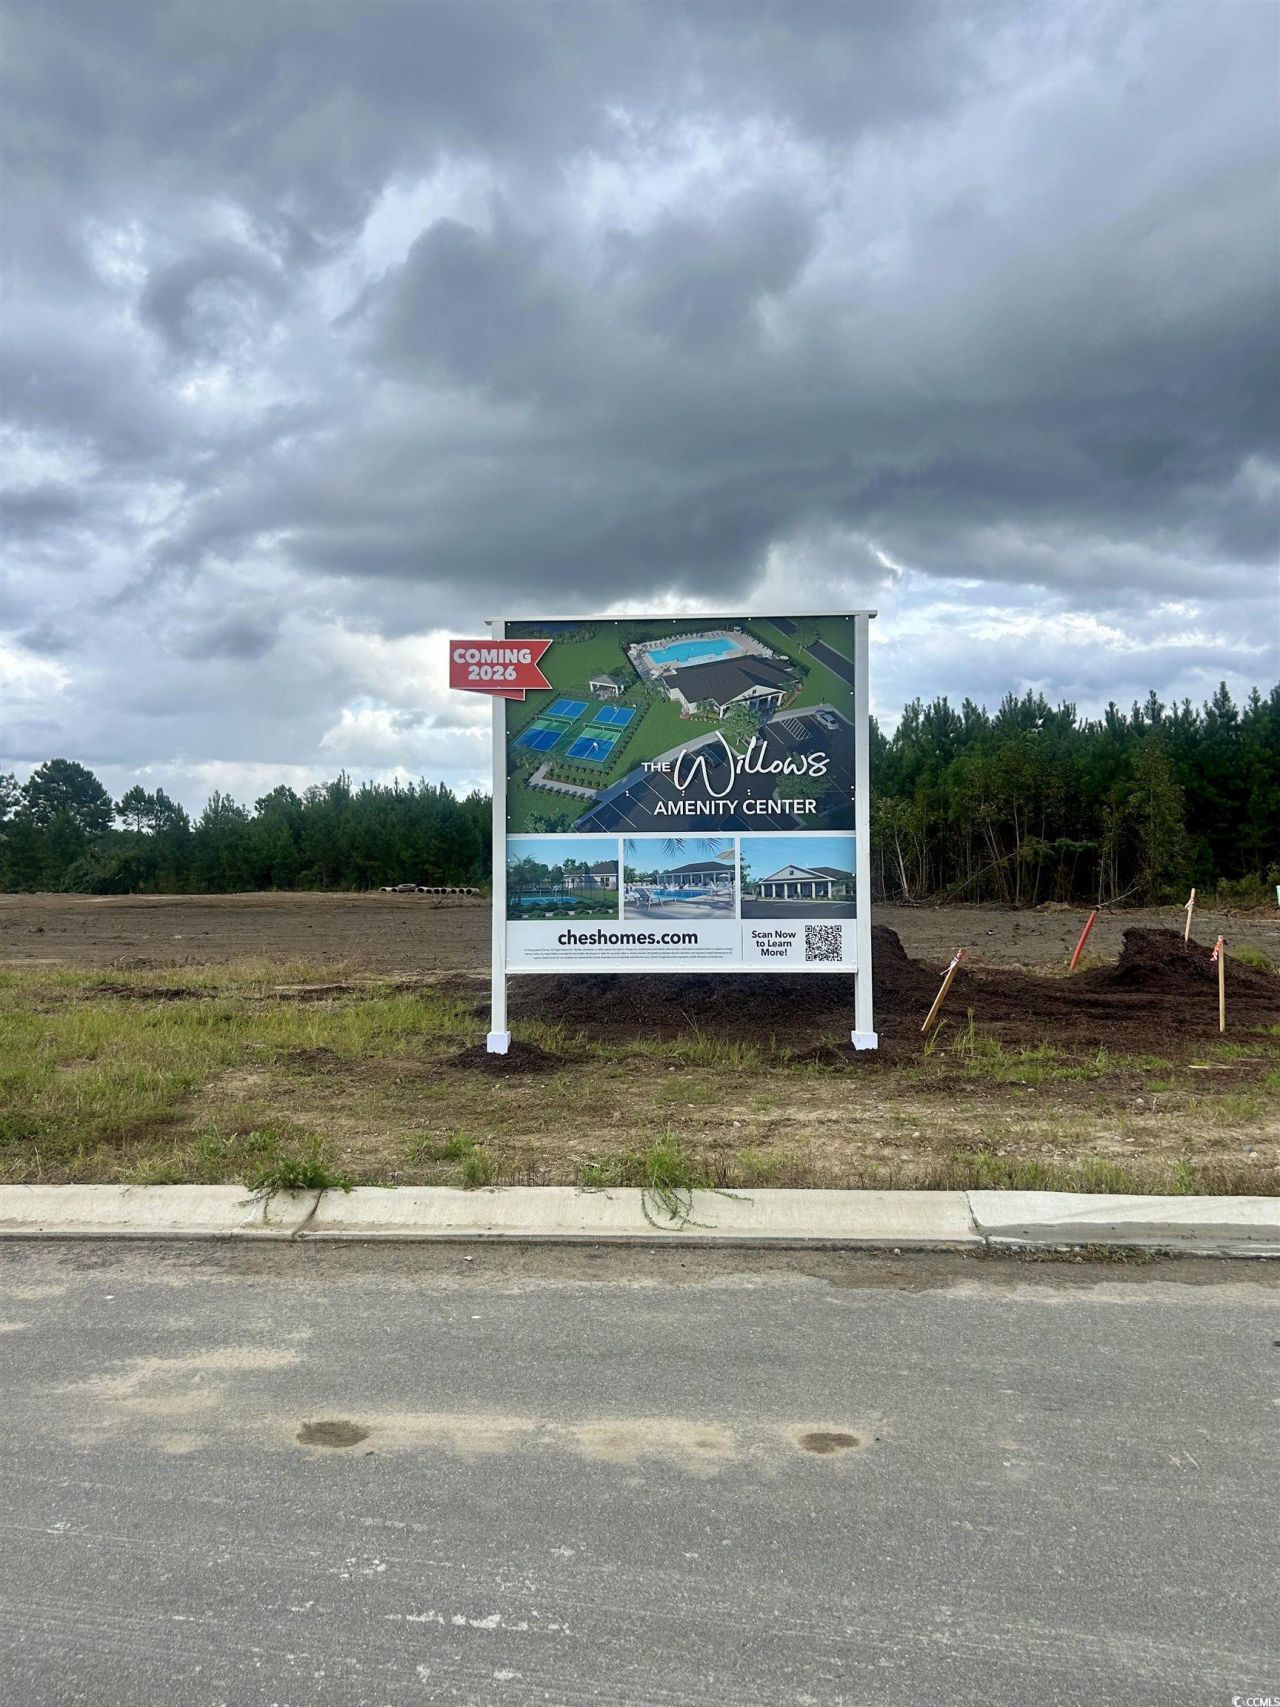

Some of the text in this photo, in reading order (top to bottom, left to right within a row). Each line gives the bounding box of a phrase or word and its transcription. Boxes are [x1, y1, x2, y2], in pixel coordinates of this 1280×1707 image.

[453, 648, 532, 664] COMING
[468, 665, 517, 681] 2026
[641, 731, 830, 797] THE Willows
[654, 799, 817, 815] AMENITY CENTER
[558, 928, 698, 945] cheshomes.com
[751, 930, 796, 939] Scan Now
[756, 939, 792, 948] to Learn
[760, 948, 788, 956] More!
